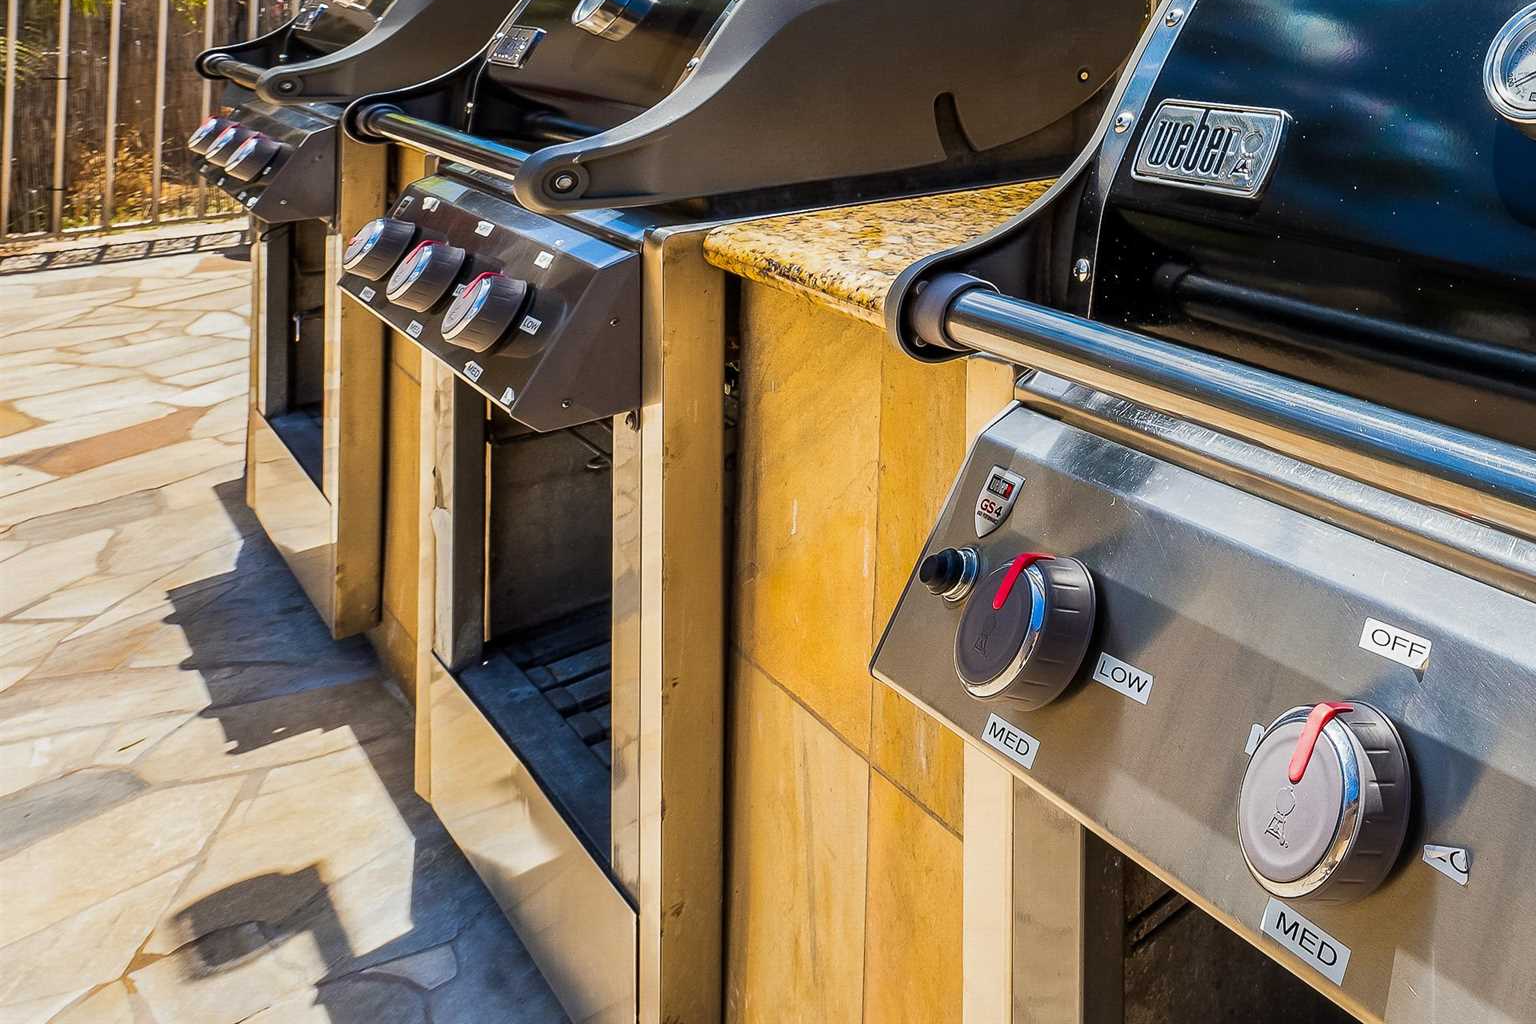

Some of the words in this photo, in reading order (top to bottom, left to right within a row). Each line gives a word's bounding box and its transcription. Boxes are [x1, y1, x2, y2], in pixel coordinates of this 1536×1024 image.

[1148, 109, 1241, 175] weber
[1371, 628, 1426, 659] OFF
[1100, 660, 1148, 693] LOW
[988, 721, 1030, 757] MED
[1275, 910, 1338, 968] MED
